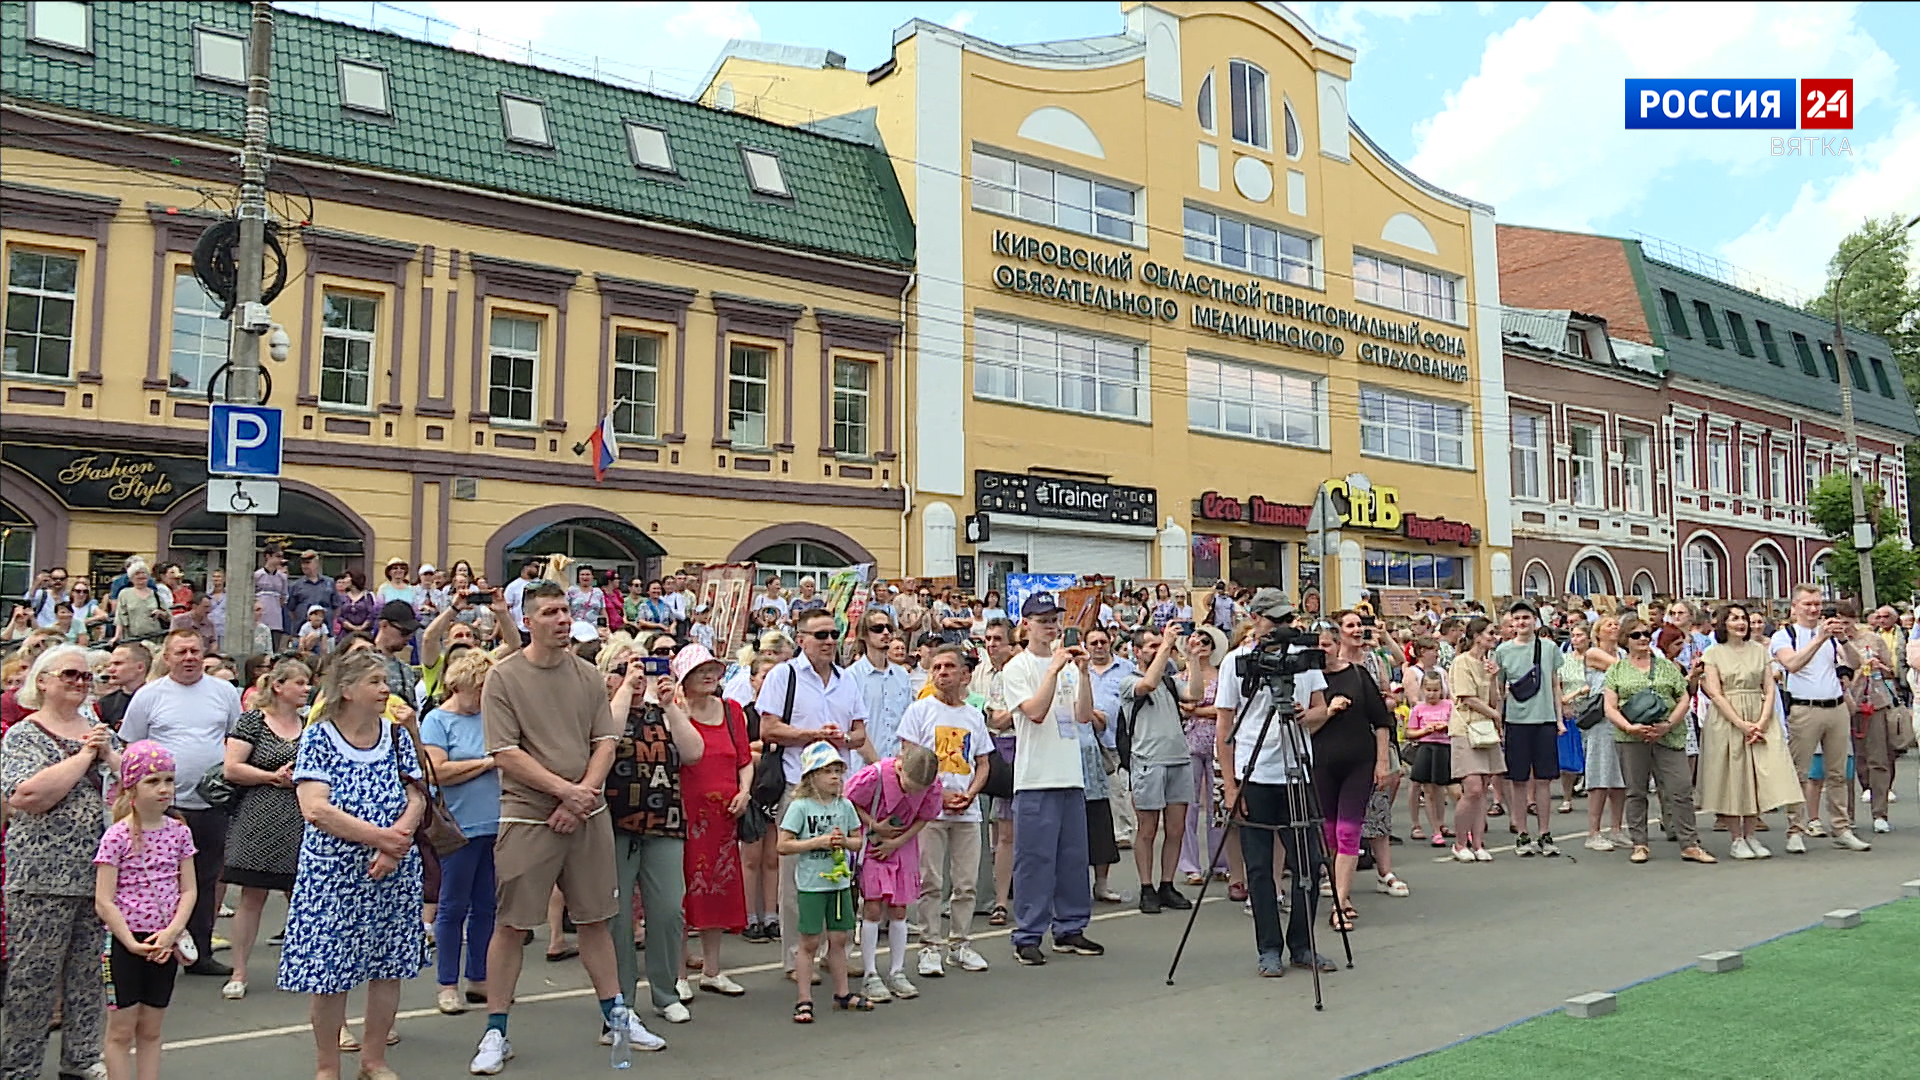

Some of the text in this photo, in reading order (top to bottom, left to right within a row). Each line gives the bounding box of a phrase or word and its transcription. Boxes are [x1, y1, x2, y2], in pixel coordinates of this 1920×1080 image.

[992, 229, 1467, 358] КИРОВСКИЙ ОБЛАСТНОЙ ТЕРРИТОРИАЛЬНЫЙ ФОНД
[993, 265, 1469, 383] ОБЯЗАТЕЛЬНОГО МЕДИЦИНСКОГО СТРАХОВАНИЯ
[226, 412, 268, 467] P
[58, 455, 156, 485] Fashion
[108, 473, 174, 506] Style
[1201, 491, 1242, 521] Сеть
